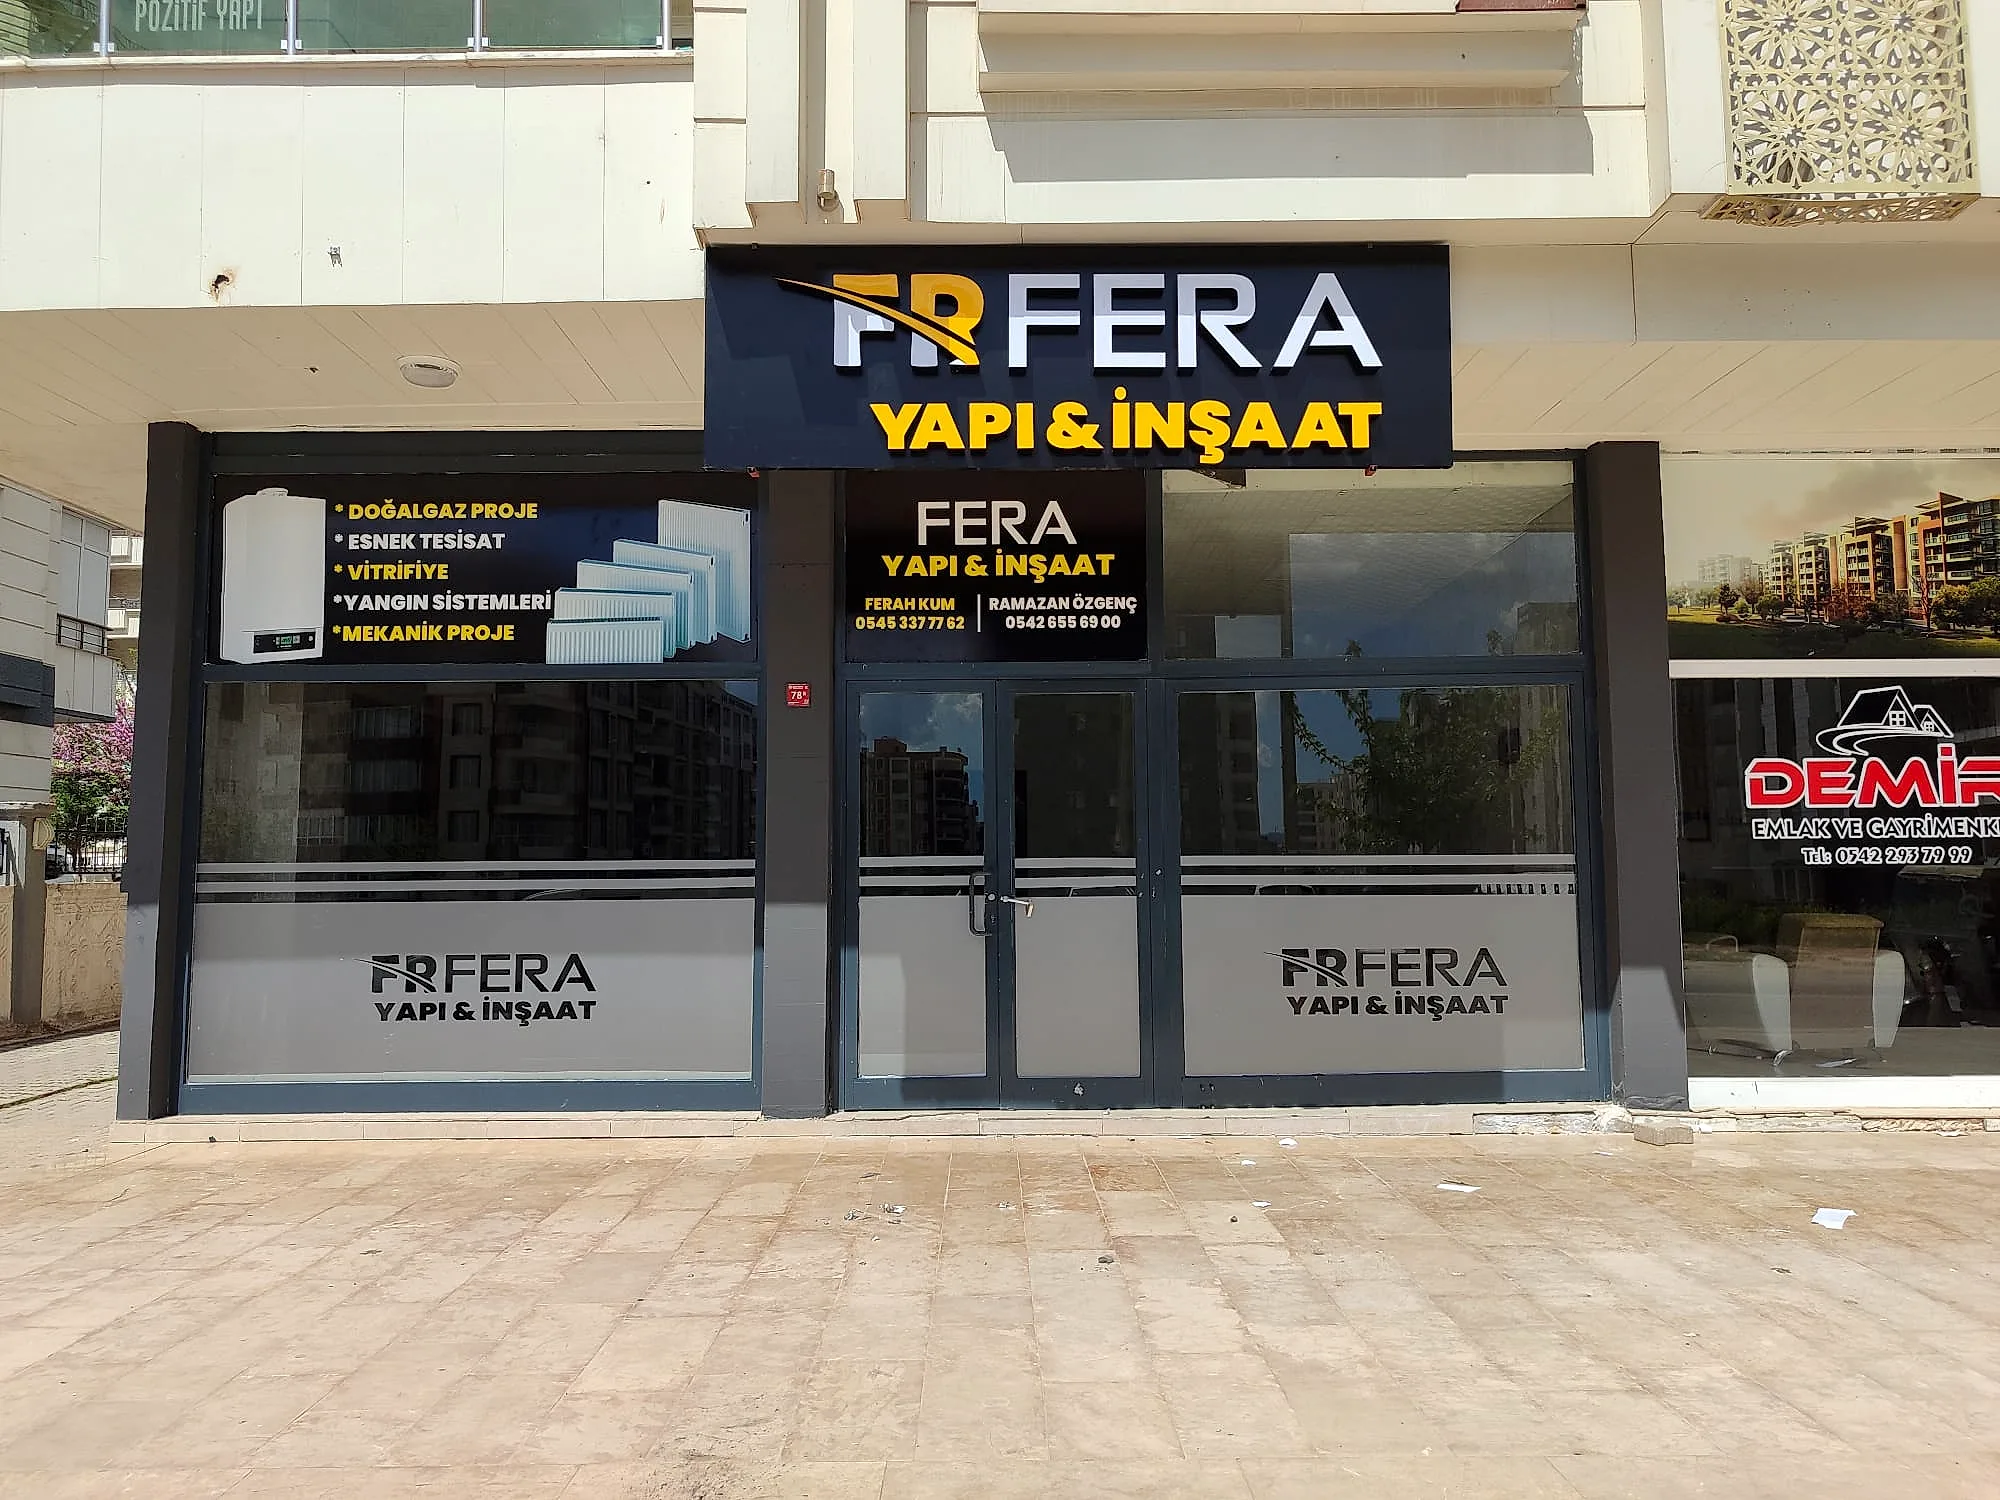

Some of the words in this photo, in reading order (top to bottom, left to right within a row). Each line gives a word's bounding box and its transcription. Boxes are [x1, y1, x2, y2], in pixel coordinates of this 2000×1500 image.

[1009, 272, 1384, 369] FERA
[870, 401, 1035, 451] YAPI
[1046, 401, 1105, 451] &
[1113, 386, 1383, 464] İNŞAAT
[348, 498, 467, 520] DOĞALGAZ
[471, 502, 538, 519] PROJE
[917, 500, 1078, 546] FERA
[348, 533, 417, 550] ESNEK
[419, 529, 506, 550] TESİSAT
[347, 559, 449, 580] VİTRİFİYE
[881, 554, 958, 578] YAPI
[964, 554, 990, 578] &
[995, 548, 1116, 584] İNŞAAT
[343, 594, 429, 611] YANGIN
[432, 589, 552, 610] SİSTEMLERİ
[865, 597, 916, 611] FERAH
[918, 597, 956, 611] KUM
[988, 596, 1070, 611] RAMAZAN
[1072, 593, 1138, 614] ÖZGENÇ
[342, 621, 444, 641] MEKANİK
[447, 624, 515, 641] PROJE
[855, 616, 896, 630] 0545
[1005, 615, 1046, 630] 0542
[1047, 615, 1077, 629] 655
[1745, 743, 2000, 808] DEMİR
[1751, 816, 1831, 840] EMLAK
[1831, 816, 1863, 839] VE
[1866, 812, 2000, 839] GAYRİMENK
[1835, 846, 1883, 865] 0542
[1885, 846, 1920, 865] 293
[1921, 845, 1945, 864] 79
[1948, 845, 1973, 864] 99
[444, 952, 597, 993] FERA
[1354, 947, 1508, 988] FERA
[374, 1001, 447, 1022] YAPI
[452, 1001, 477, 1021] &
[482, 995, 597, 1027] İNŞAAT
[1286, 995, 1359, 1016] YAPI
[1365, 995, 1389, 1015] &
[1394, 990, 1509, 1022] İNŞAAT
